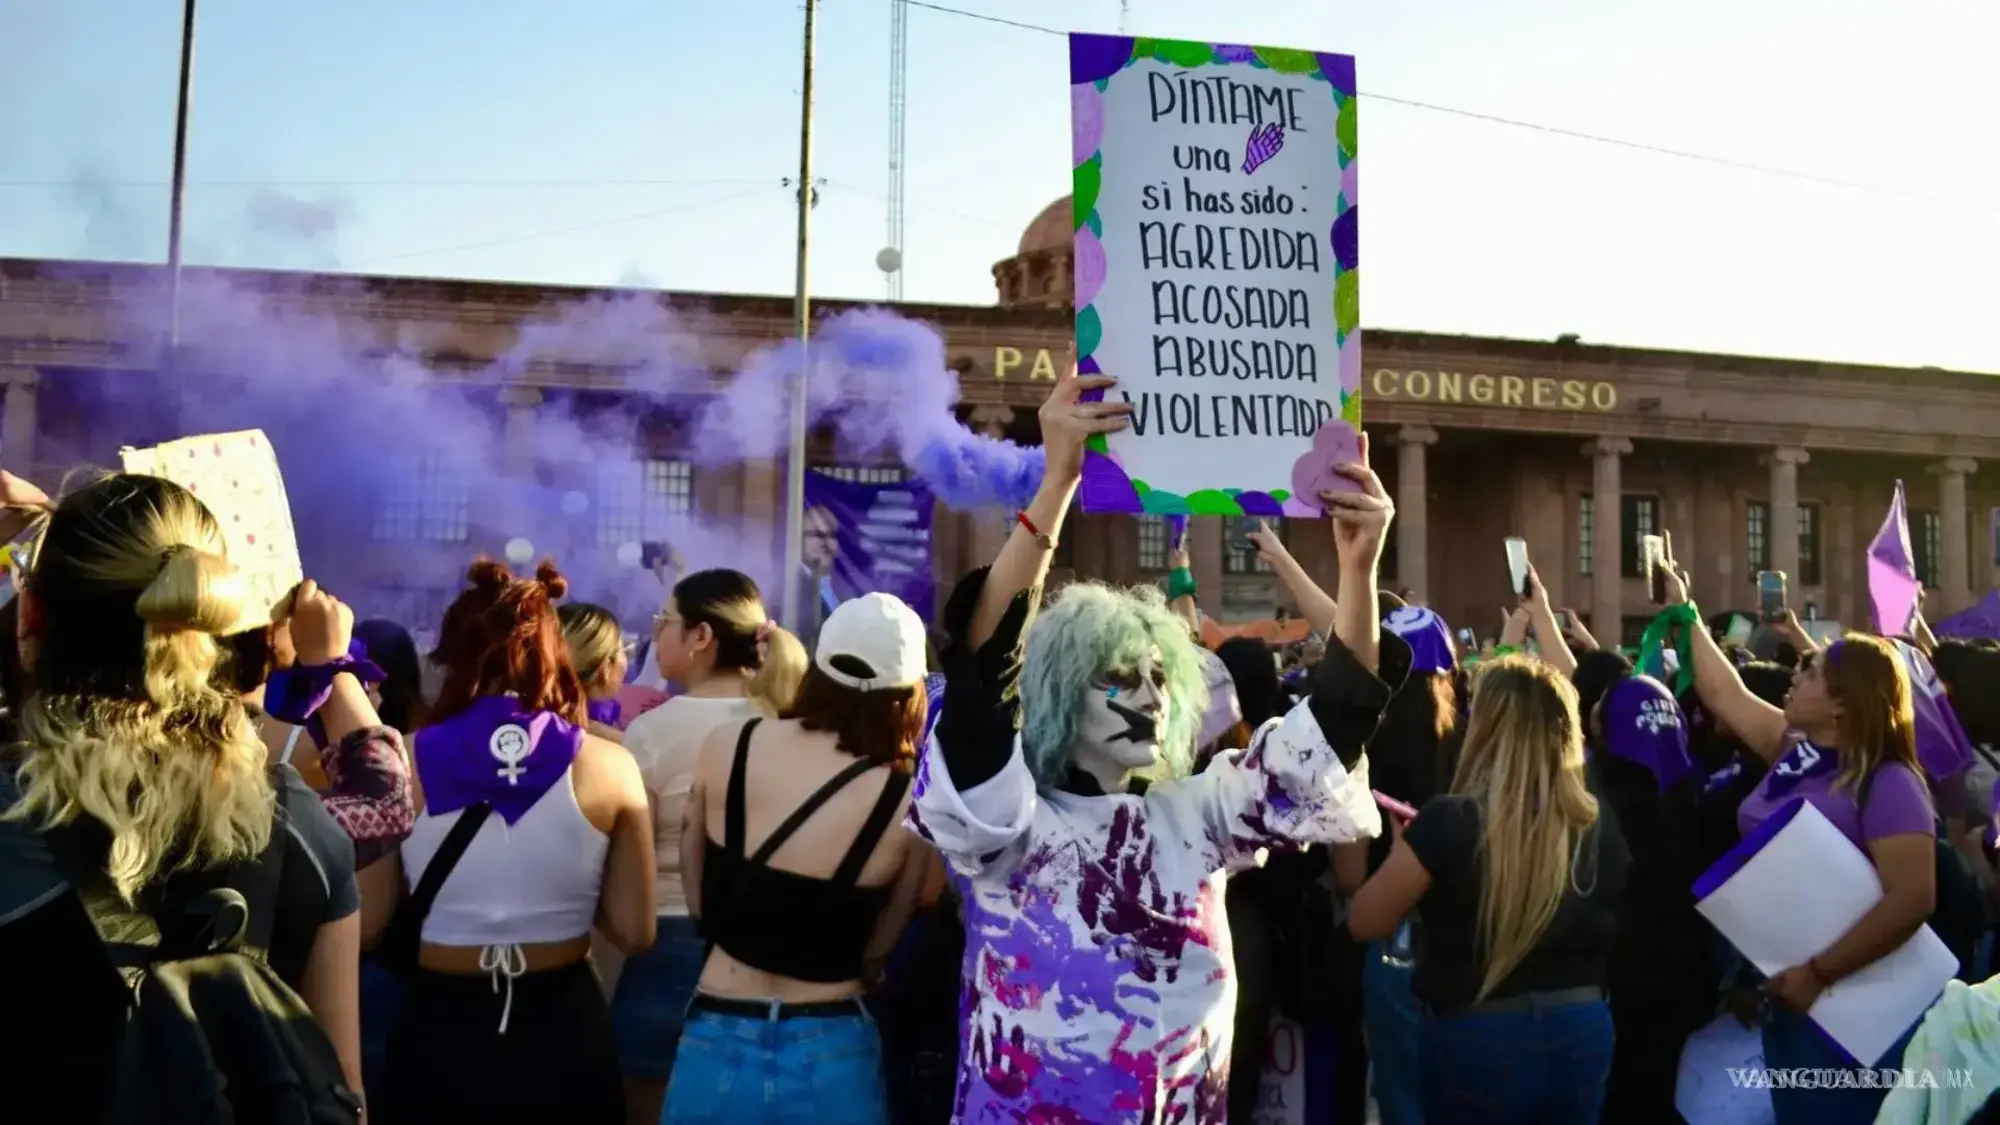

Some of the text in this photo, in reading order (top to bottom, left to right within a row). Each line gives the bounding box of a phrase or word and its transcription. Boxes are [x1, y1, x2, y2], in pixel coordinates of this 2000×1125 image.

[1173, 145, 1231, 173] una
[1142, 181, 1171, 211] si
[1183, 177, 1235, 214] has
[1139, 221, 1319, 273] AGREDIDA
[1151, 279, 1310, 329] ACOSADA
[1152, 334, 1317, 383] ABUSADA
[1373, 368, 1617, 412] CONGRESO
